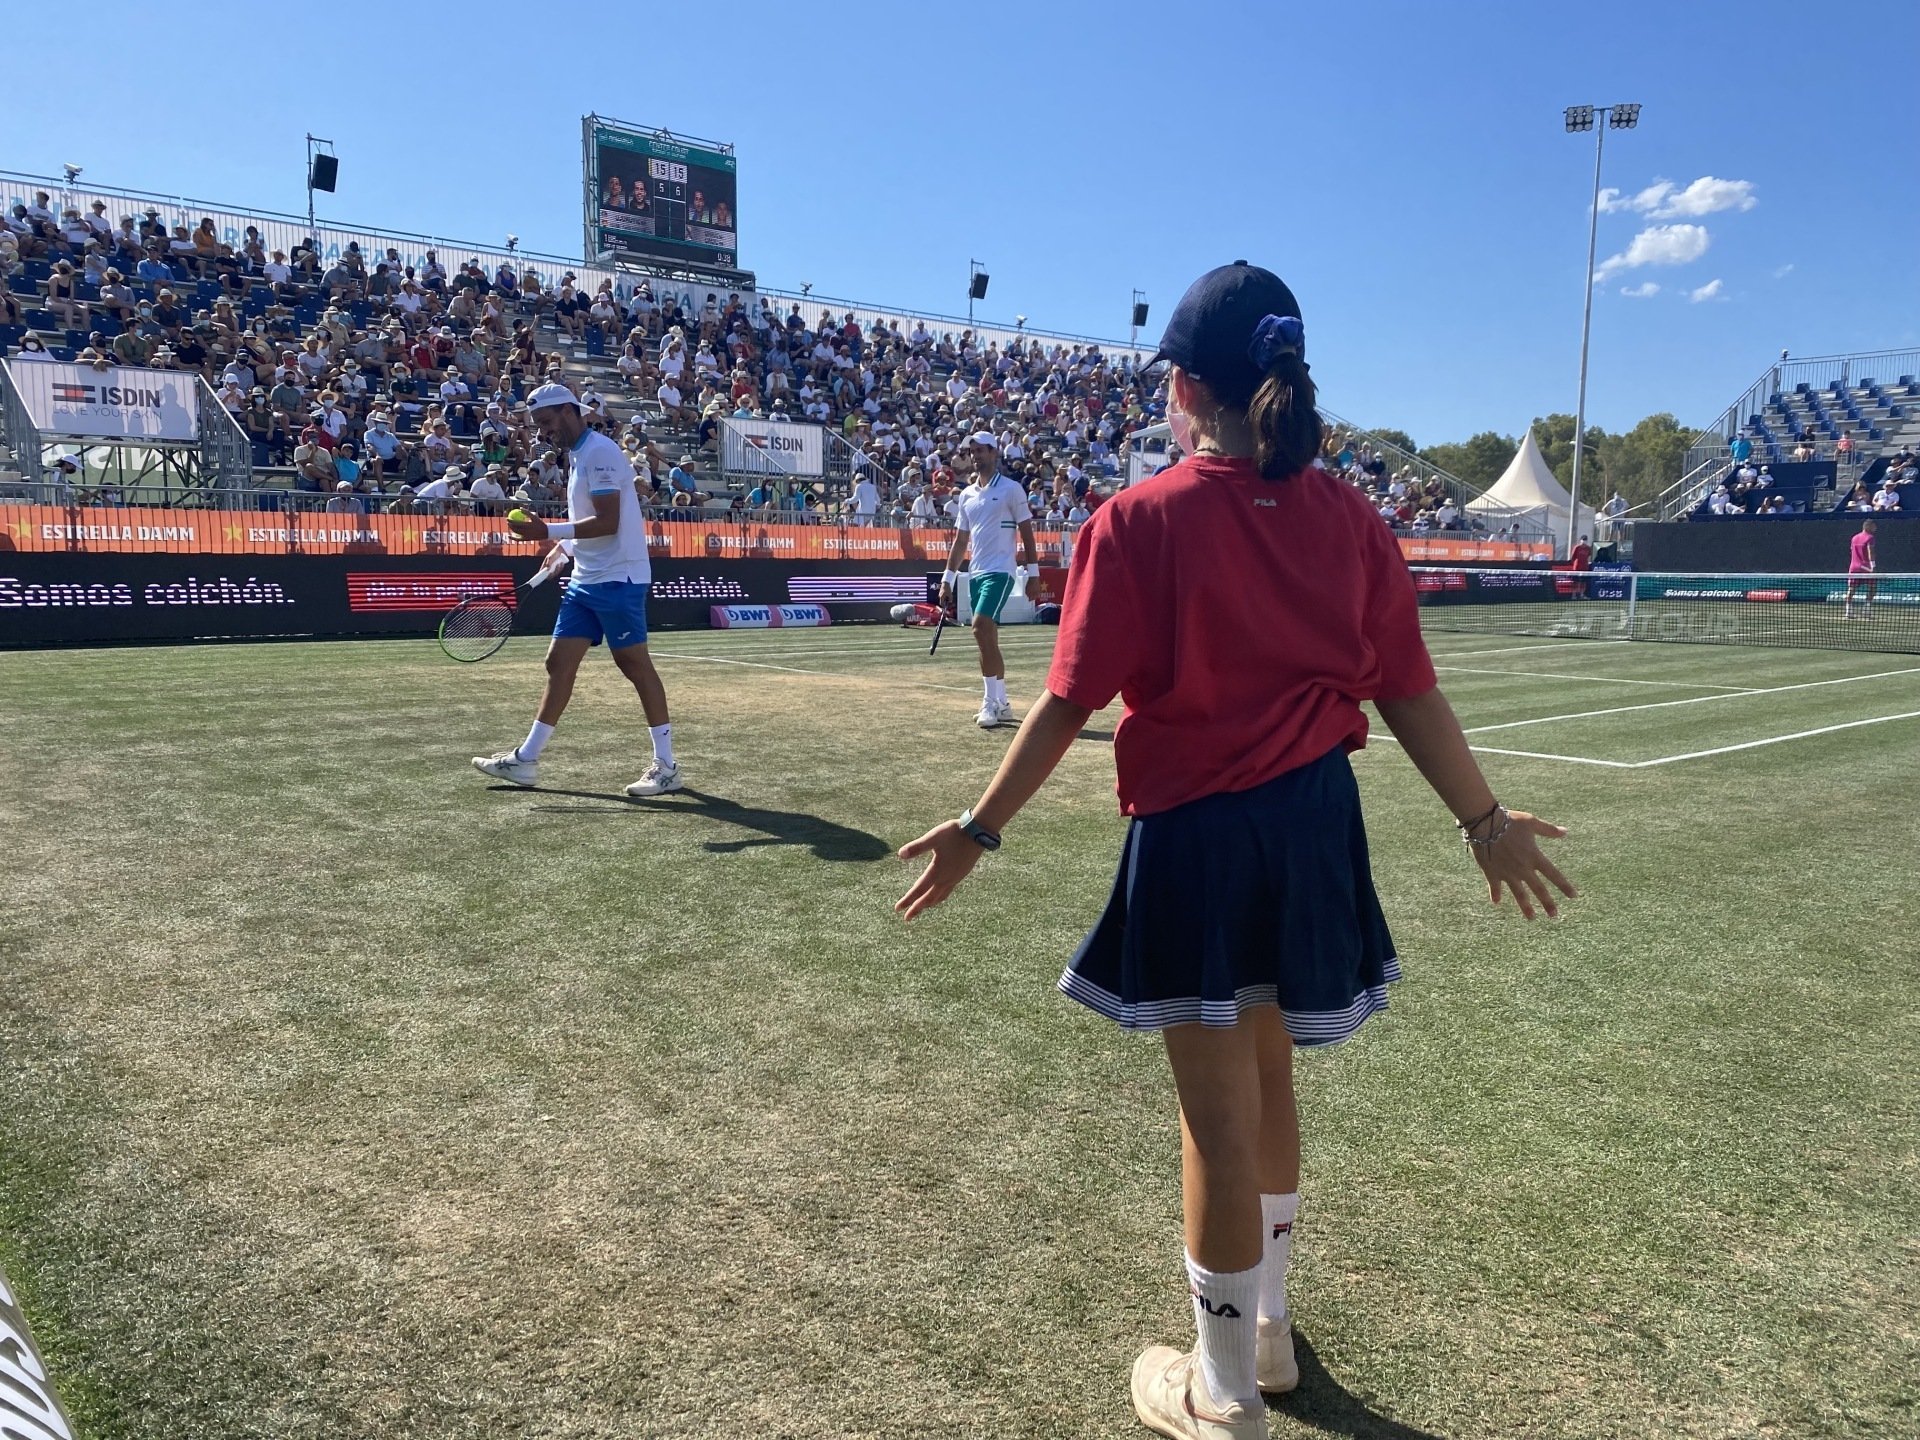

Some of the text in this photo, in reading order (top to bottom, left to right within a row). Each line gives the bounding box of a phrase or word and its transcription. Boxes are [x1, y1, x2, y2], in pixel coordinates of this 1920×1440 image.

[655, 163, 684, 179] 15 15
[659, 183, 665, 192] 5
[101, 386, 160, 408] ISDIN
[53, 404, 162, 420] LOVE YOUR SKIN
[771, 436, 803, 452] ISDIN
[1253, 498, 1277, 507] FILA
[41, 524, 195, 541] ESTRELLA DAMM
[248, 528, 379, 543] ESTRELLA DAMM
[423, 530, 488, 544] ESTRELLA
[708, 536, 795, 549] ESTRELLA DAMM
[824, 538, 899, 550] ESTRELLA DAMM
[0, 577, 295, 607] Somos colchón.
[740, 608, 823, 621] BWT BWT
